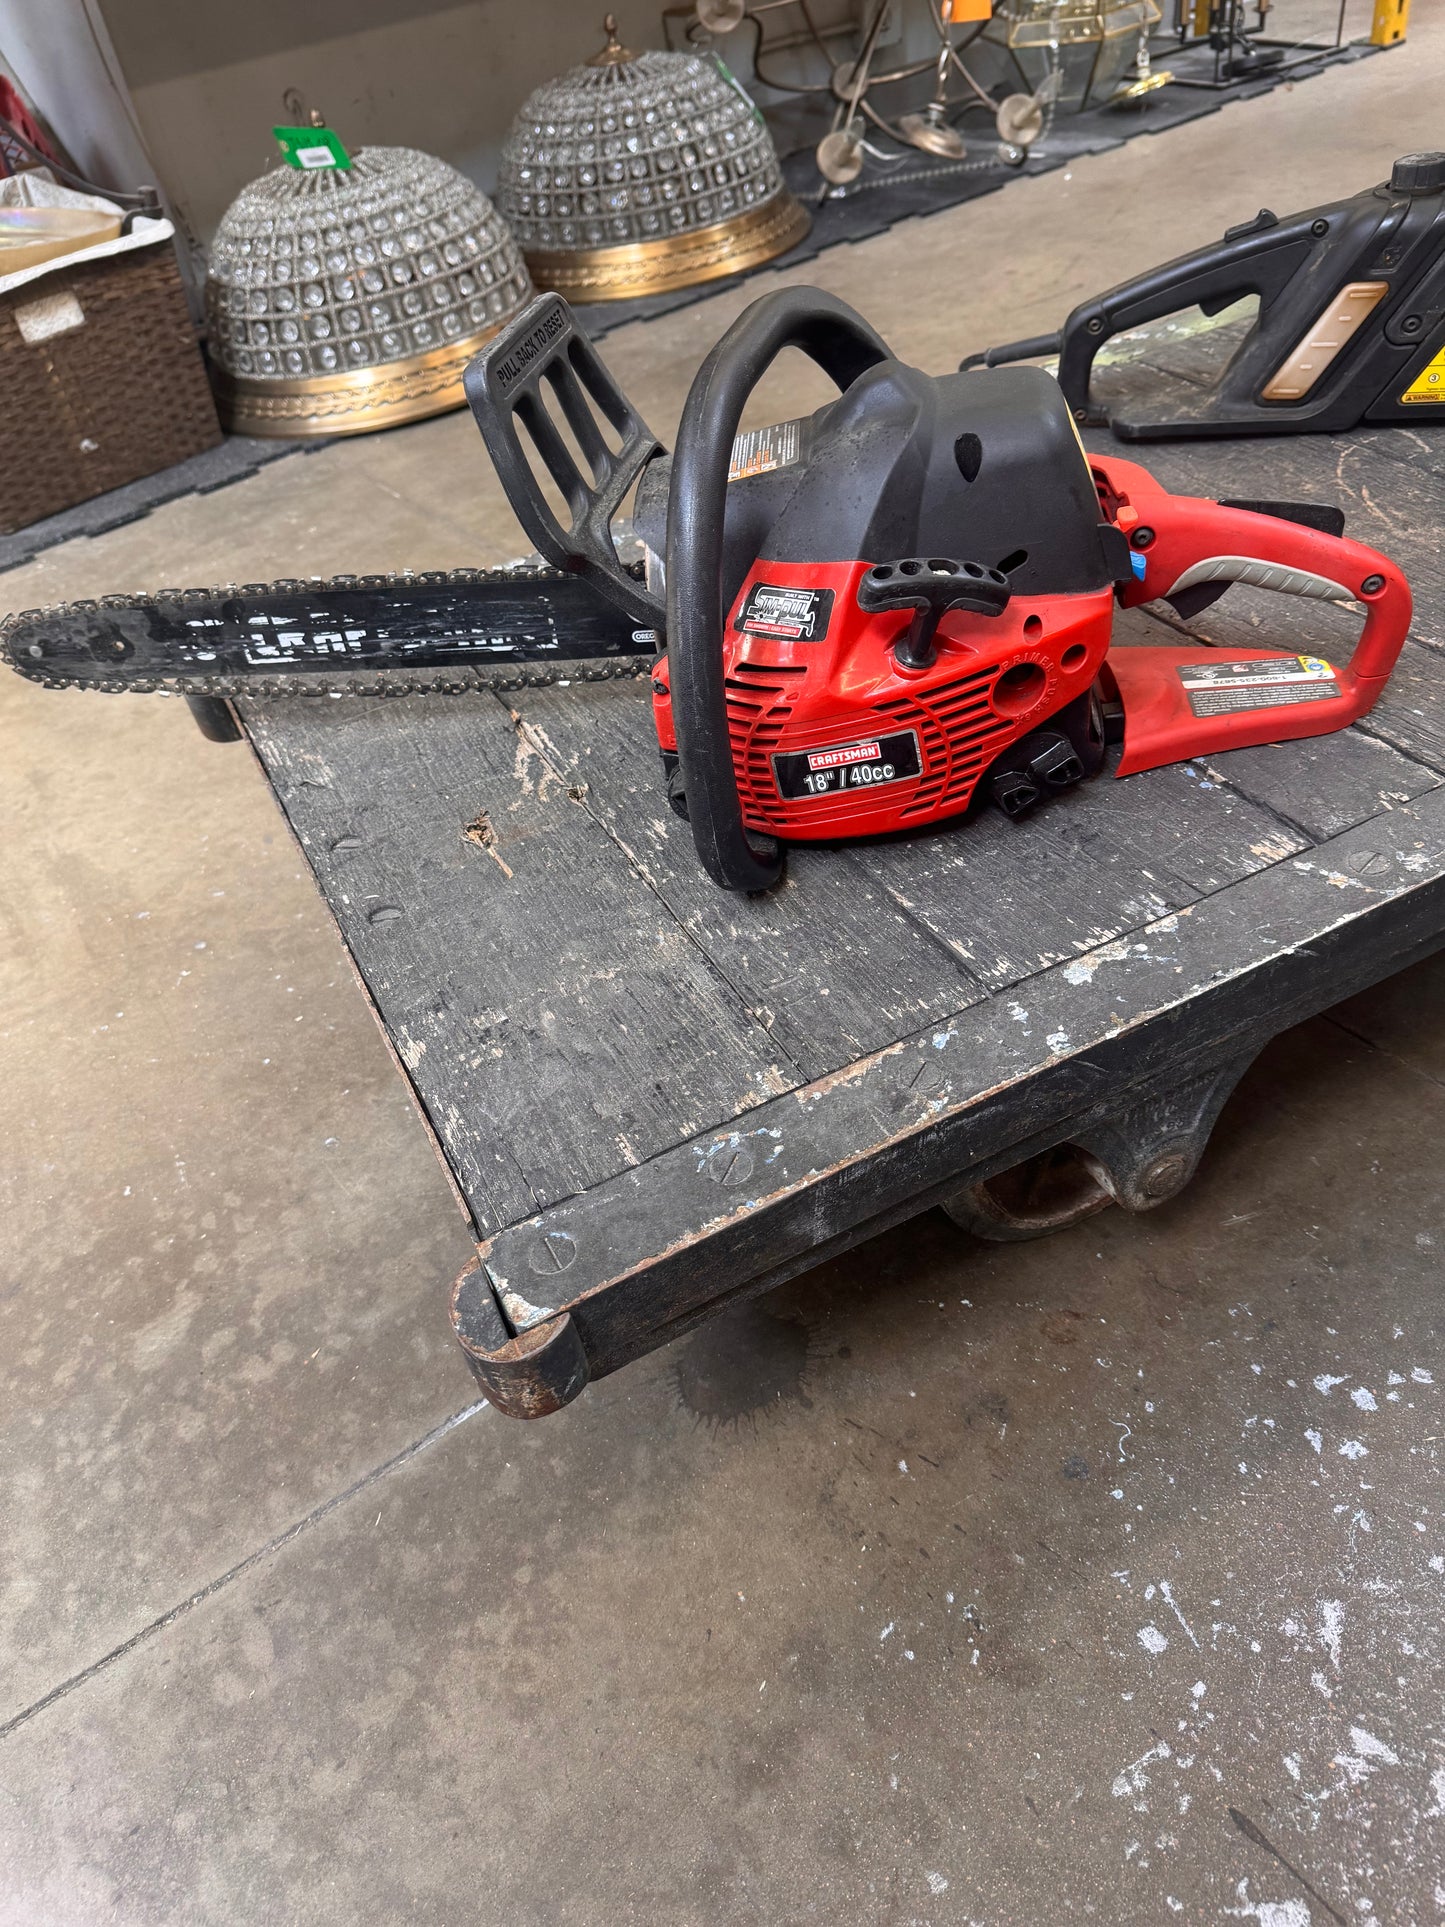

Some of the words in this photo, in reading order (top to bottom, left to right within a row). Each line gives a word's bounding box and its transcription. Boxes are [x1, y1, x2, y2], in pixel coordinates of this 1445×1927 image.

[496, 358, 521, 387] PULL
[515, 337, 539, 367] BACK
[534, 328, 547, 349] TO
[543, 309, 565, 339] RESET
[1001, 651, 1055, 673] PRIMER
[1034, 678, 1058, 712] PUSH
[804, 769, 835, 794] 18"
[850, 763, 895, 785] 40cc
[811, 746, 877, 767] CRAFTSMAN
